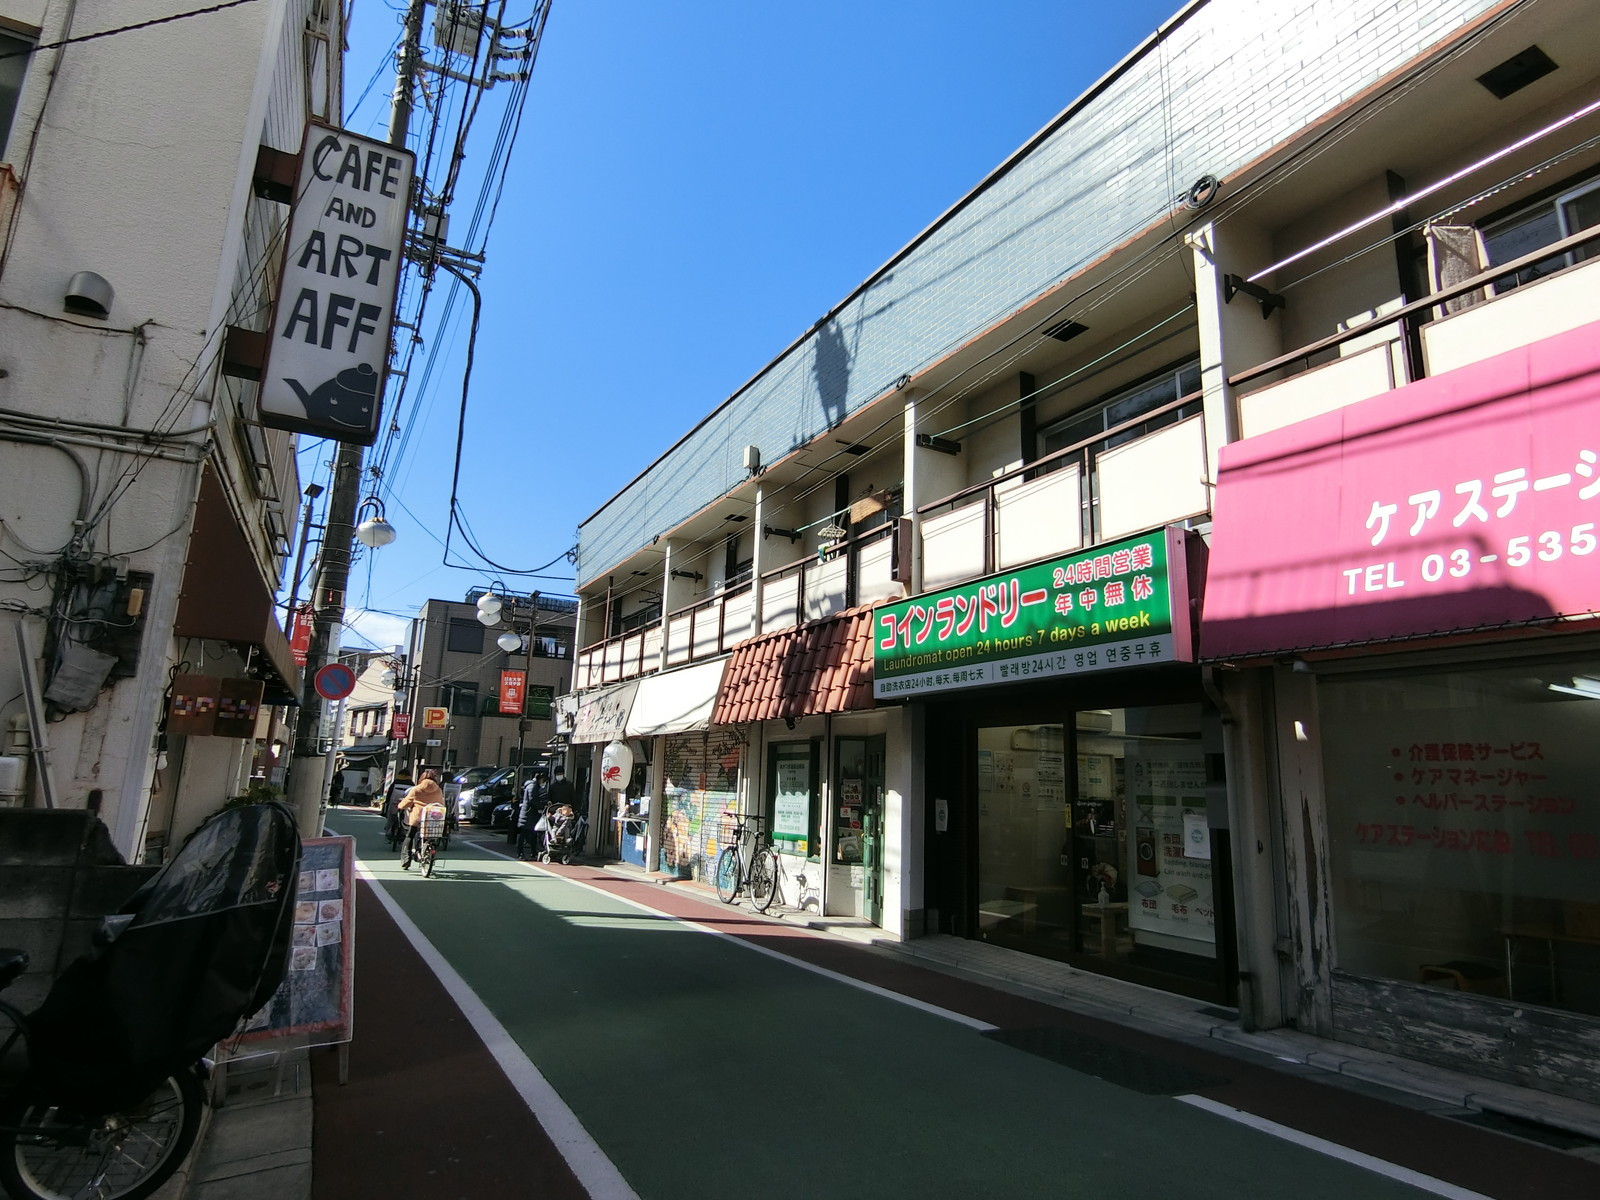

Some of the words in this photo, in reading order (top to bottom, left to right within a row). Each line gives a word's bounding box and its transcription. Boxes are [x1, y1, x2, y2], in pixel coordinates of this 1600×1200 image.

[312, 135, 403, 199] CAFE
[325, 197, 377, 229] AND
[297, 230, 392, 286] ART
[282, 287, 382, 353] AFF
[1053, 544, 1153, 588] 24時間営業
[1343, 561, 1404, 595] TEL
[1420, 522, 1597, 583] 03-535
[880, 578, 1047, 650] コインランドリー
[1054, 574, 1153, 616] 年中無休
[884, 650, 942, 671] Laundromat
[945, 646, 973, 661] open
[976, 640, 990, 655] 24
[994, 635, 1033, 652] hours
[1037, 629, 1045, 644] 7
[1050, 625, 1086, 642] days
[1091, 622, 1100, 635] a
[1105, 610, 1150, 633] week
[1073, 650, 1097, 668] 영업
[1106, 641, 1161, 663] 연중무휴
[427, 709, 445, 724] P
[1408, 742, 1545, 762] 介護保険サービス
[1411, 768, 1547, 787] ケアマネージャー
